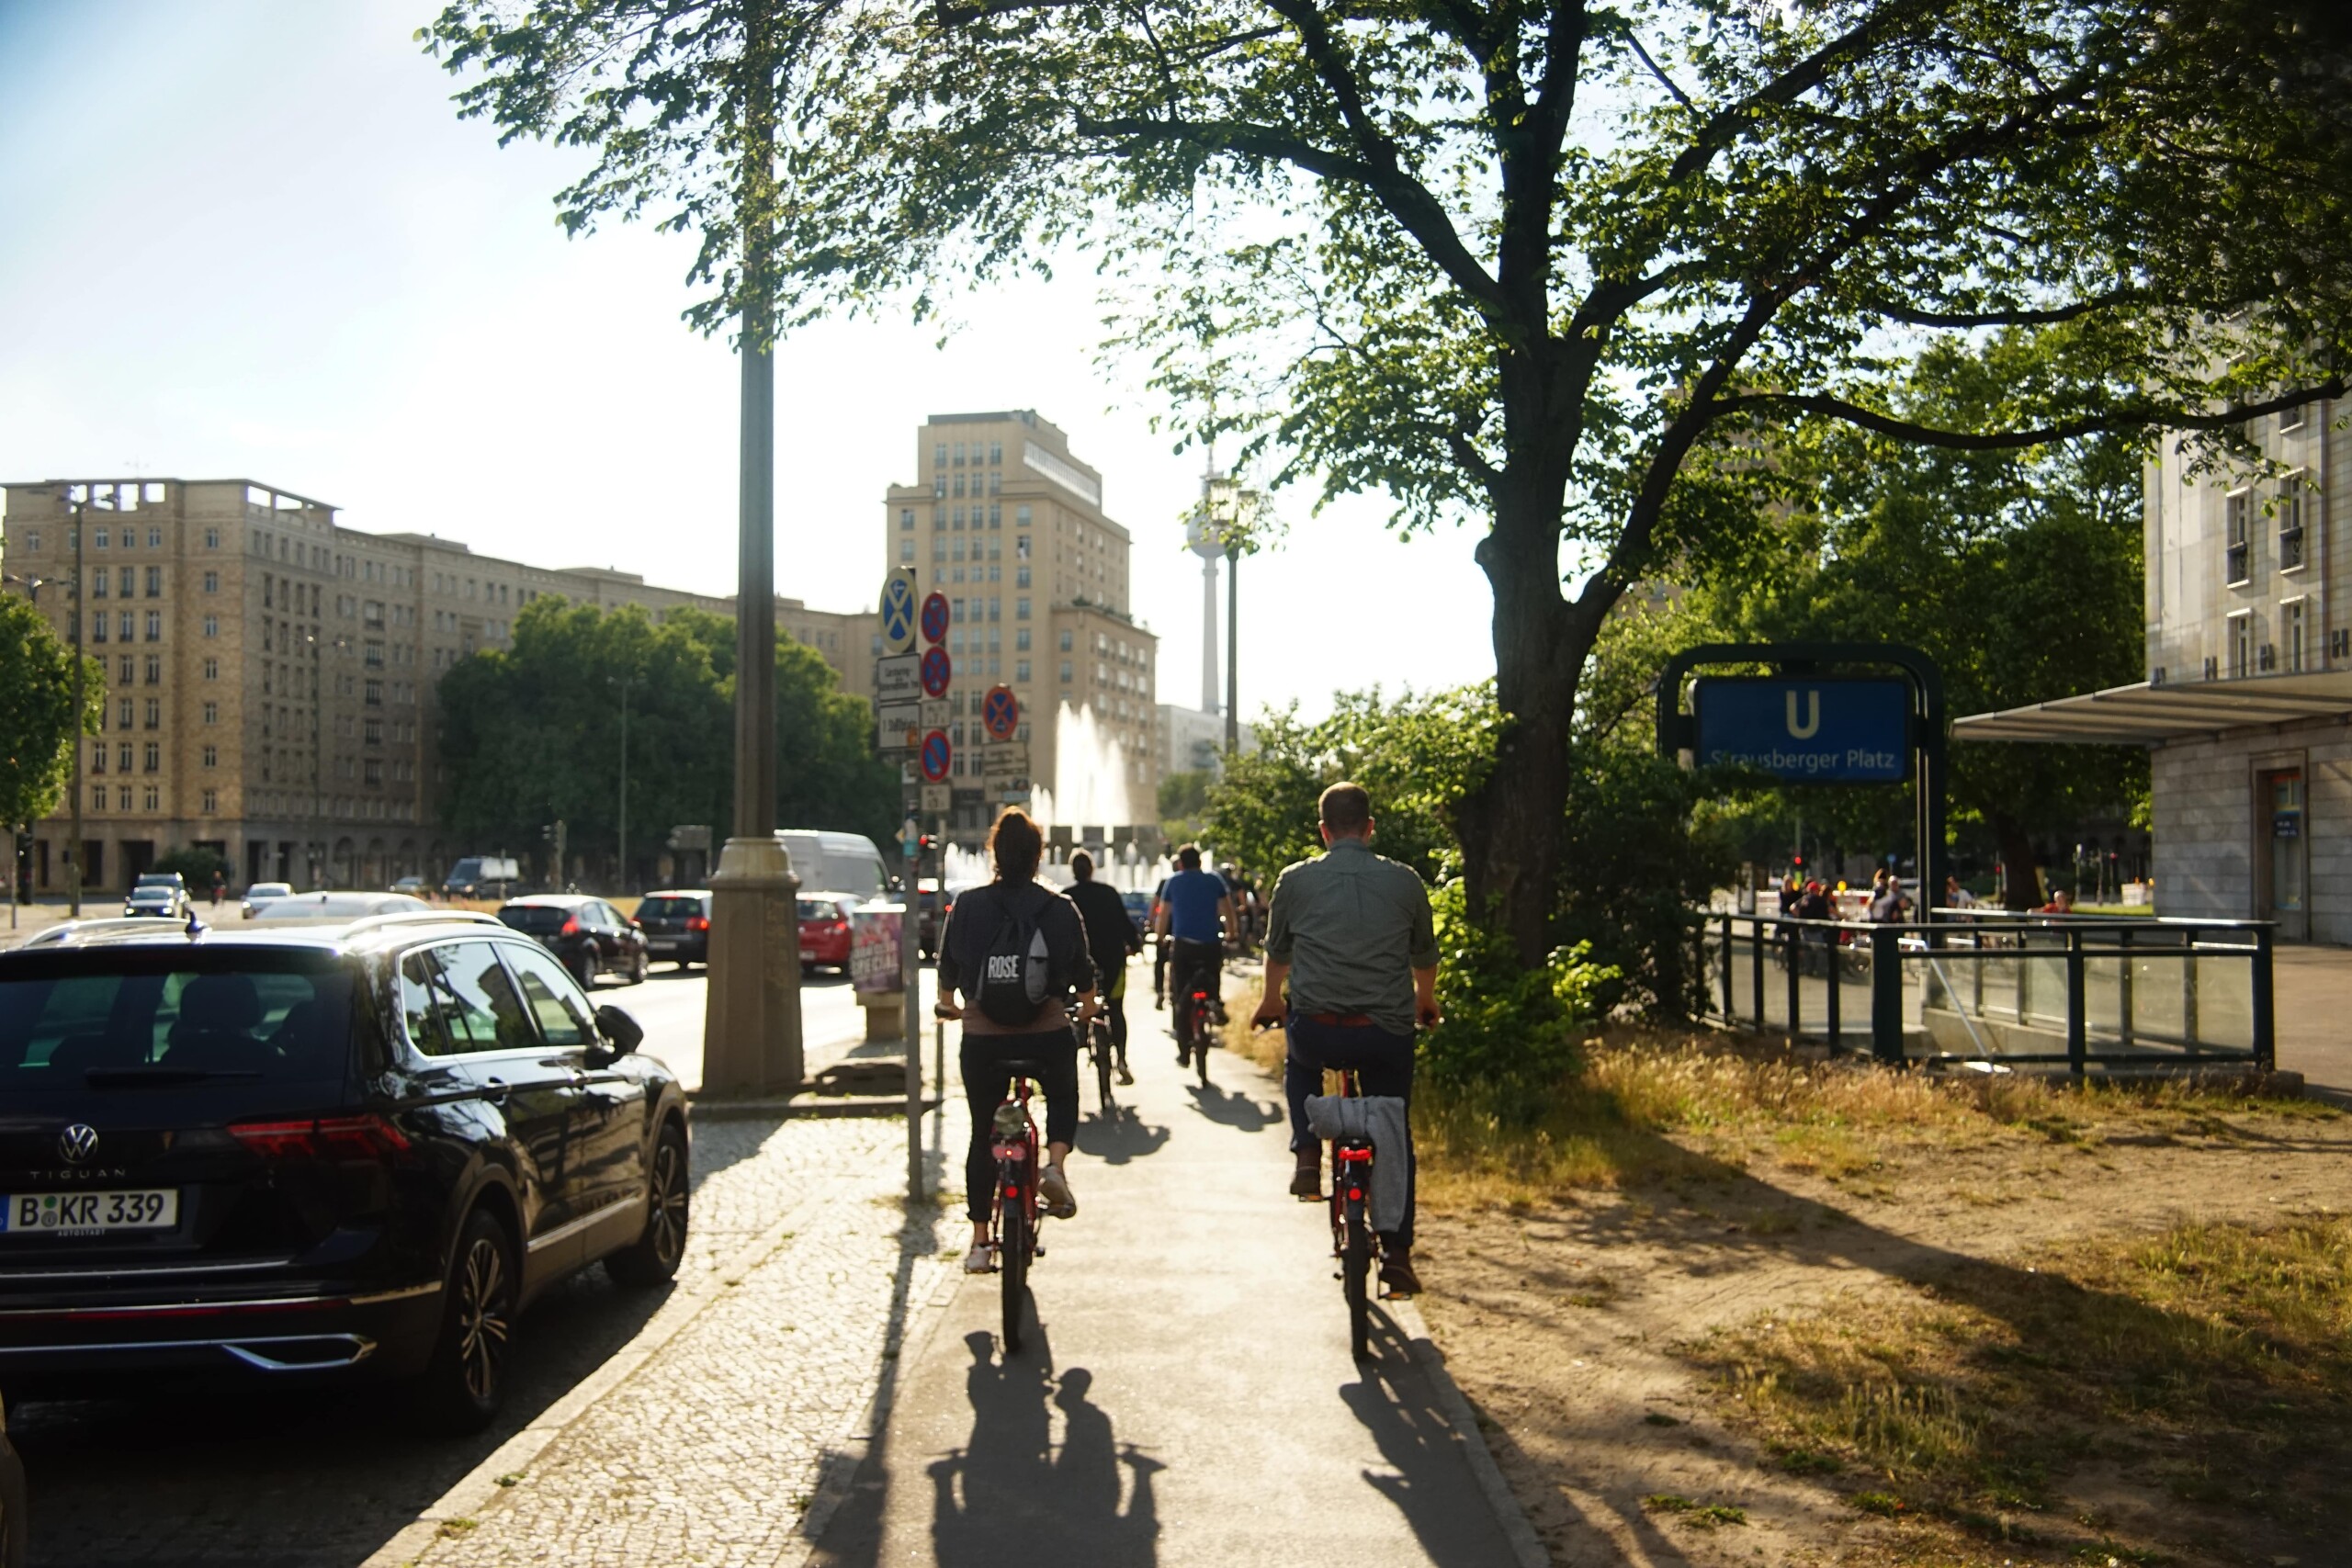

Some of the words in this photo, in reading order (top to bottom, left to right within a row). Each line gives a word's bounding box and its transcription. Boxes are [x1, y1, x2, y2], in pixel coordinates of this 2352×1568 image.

[1786, 690, 1820, 739] U
[1711, 749, 1840, 773] Srausberger
[1847, 749, 1895, 769] Platz
[987, 954, 1021, 979] ROSE
[30, 1168, 126, 1179] TIGUAN
[19, 1197, 40, 1227] B
[60, 1195, 99, 1226] KR
[107, 1193, 164, 1224] 339
